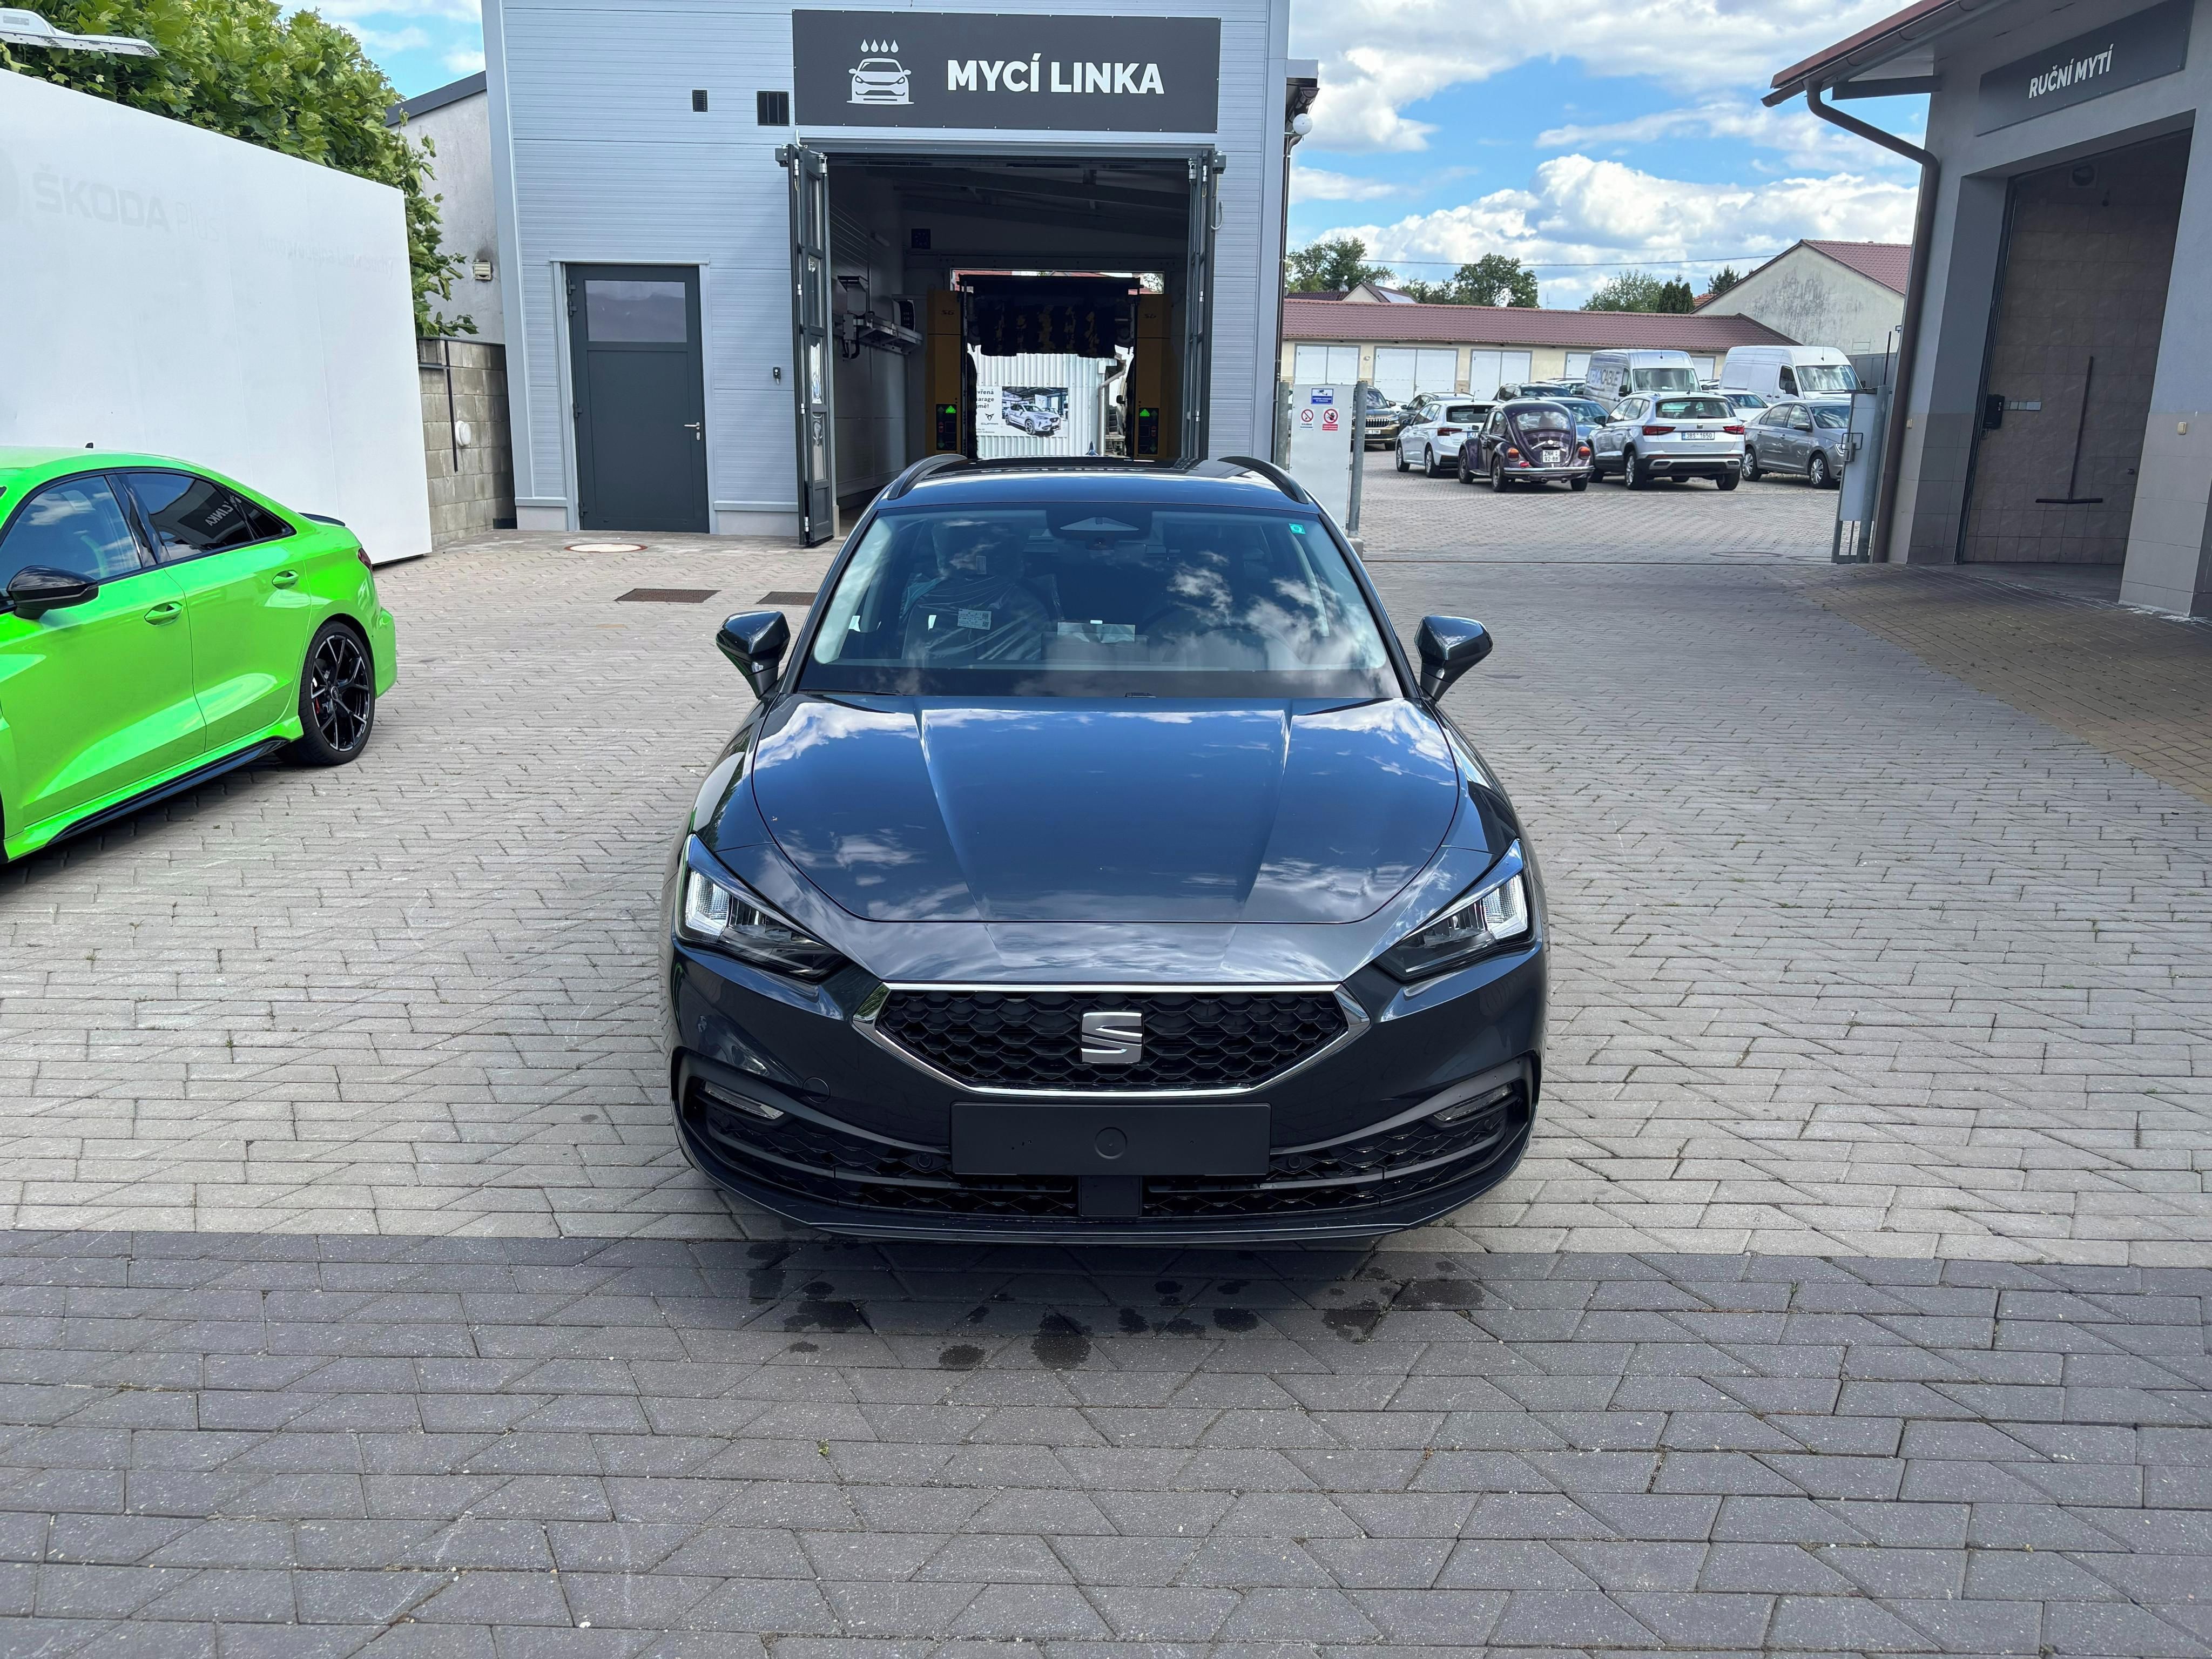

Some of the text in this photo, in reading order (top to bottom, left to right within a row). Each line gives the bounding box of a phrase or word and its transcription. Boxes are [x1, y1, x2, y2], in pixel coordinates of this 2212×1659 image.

[947, 52, 1165, 95] MYCÍ LINKA
[2028, 43, 2114, 99] RUČNÍ MYTÍ
[32, 161, 170, 232] ŠKODA
